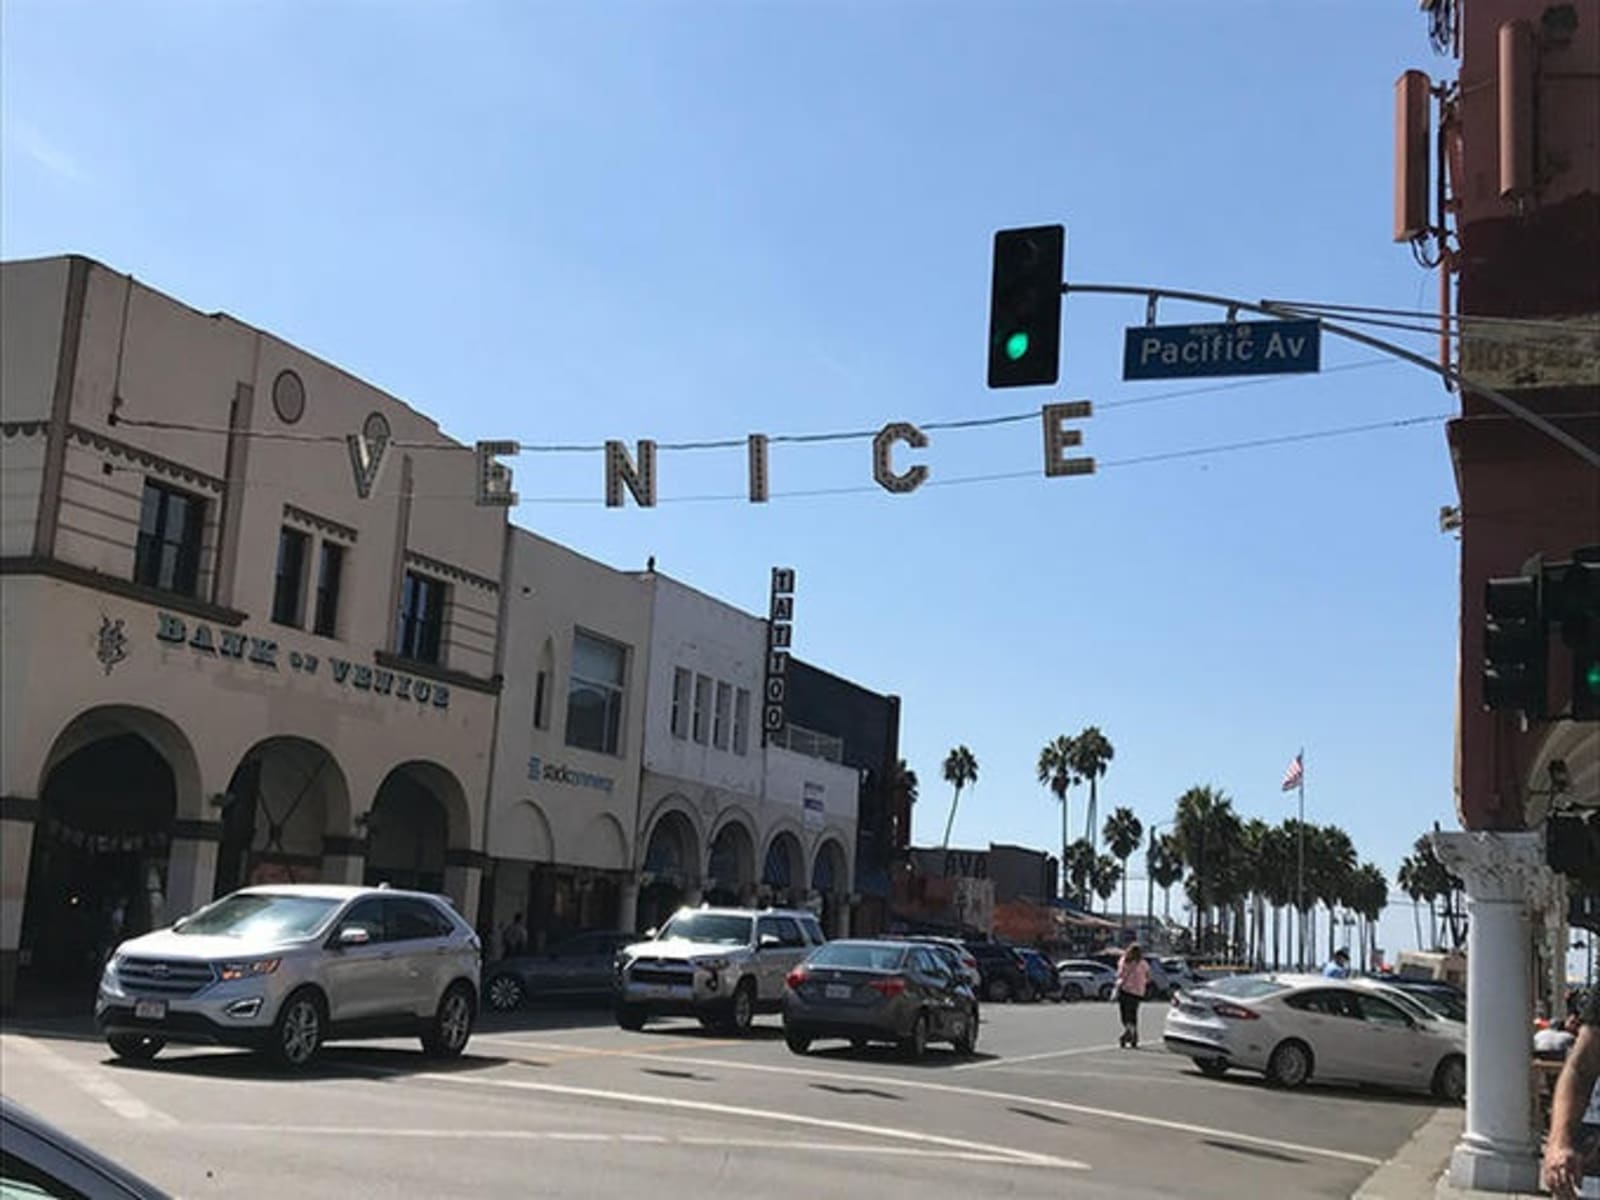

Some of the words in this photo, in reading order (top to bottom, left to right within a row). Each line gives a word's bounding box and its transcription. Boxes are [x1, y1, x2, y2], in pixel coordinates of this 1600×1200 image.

[1140, 333, 1254, 365] Pacific
[1265, 331, 1305, 359] Av
[346, 401, 1095, 507] VENICE
[156, 612, 278, 669] BANK
[329, 657, 450, 708] VENICE
[765, 568, 792, 731] TATTOO
